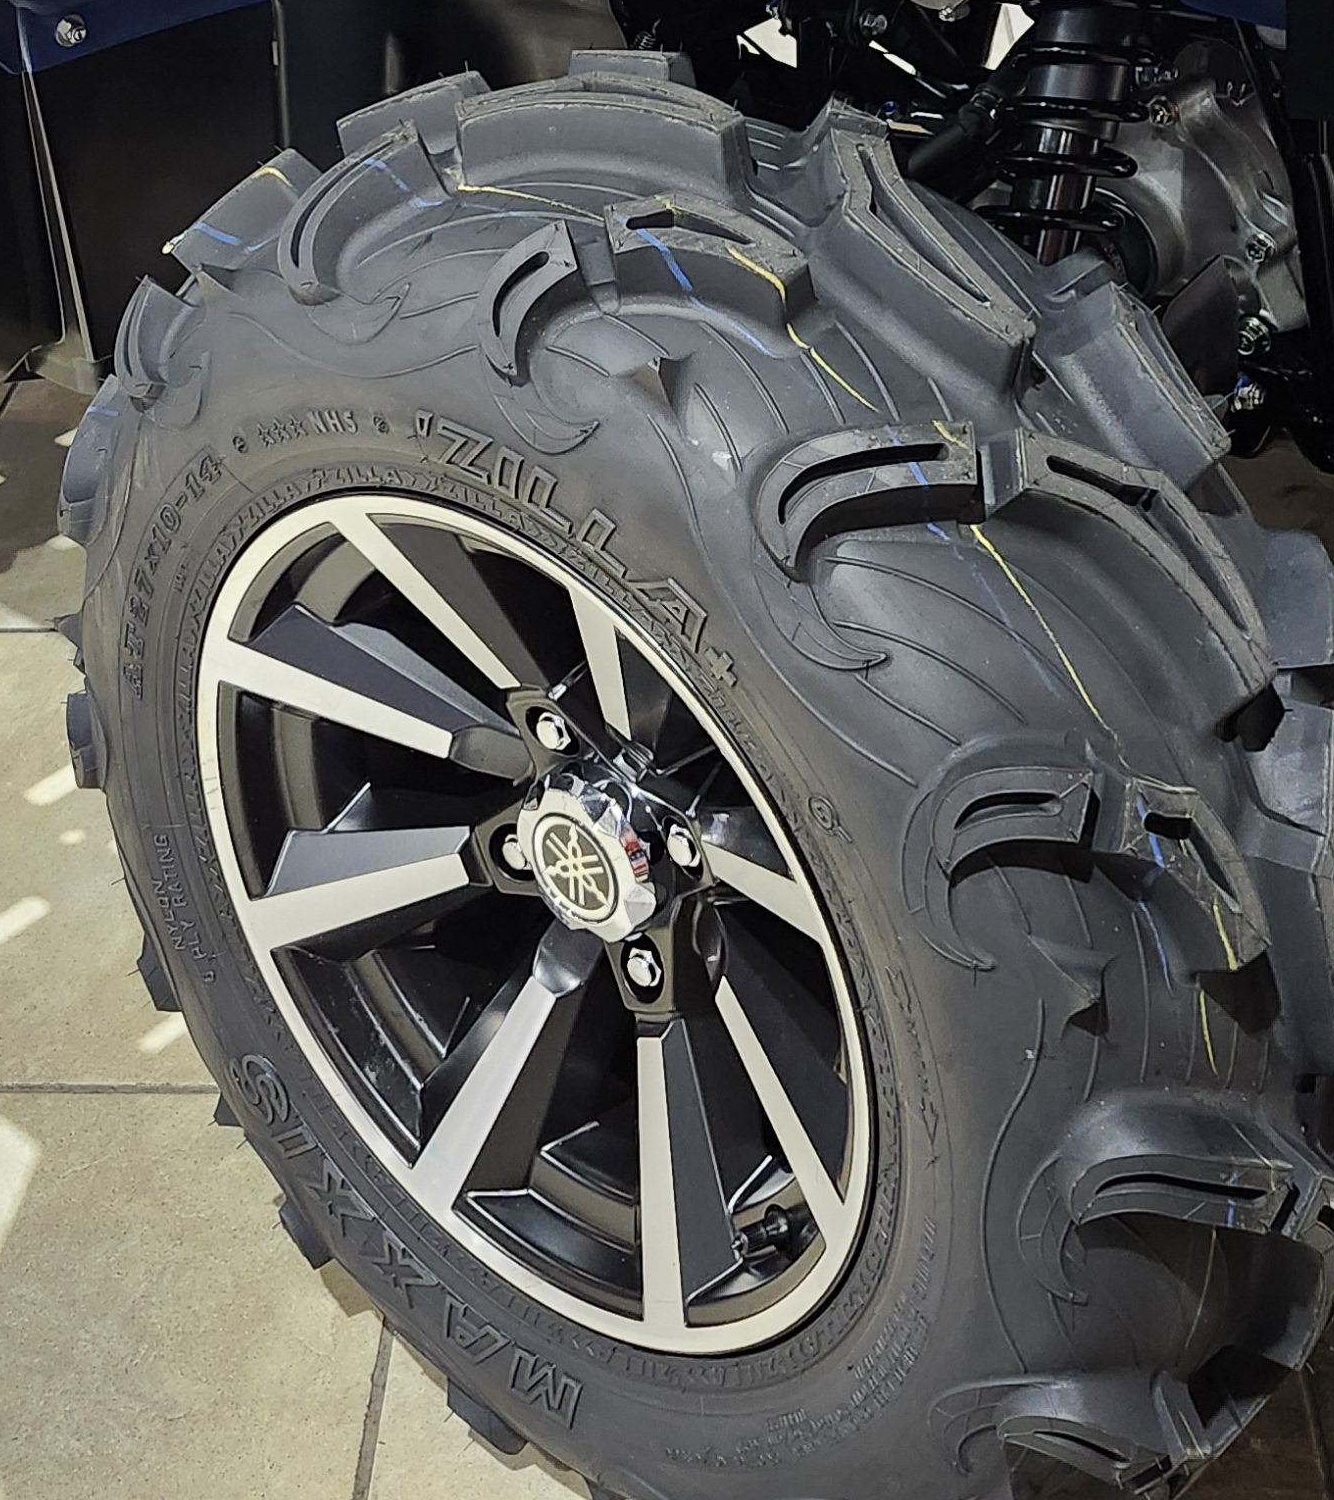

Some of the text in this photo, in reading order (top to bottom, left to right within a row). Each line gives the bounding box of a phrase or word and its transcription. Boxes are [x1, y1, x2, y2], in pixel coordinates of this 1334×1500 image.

[307, 410, 358, 434] NHS
[154, 835, 187, 907] RATING
[152, 880, 186, 950] NYLON
[181, 920, 207, 960] PLY
[230, 1053, 583, 1429] MAXXIS
